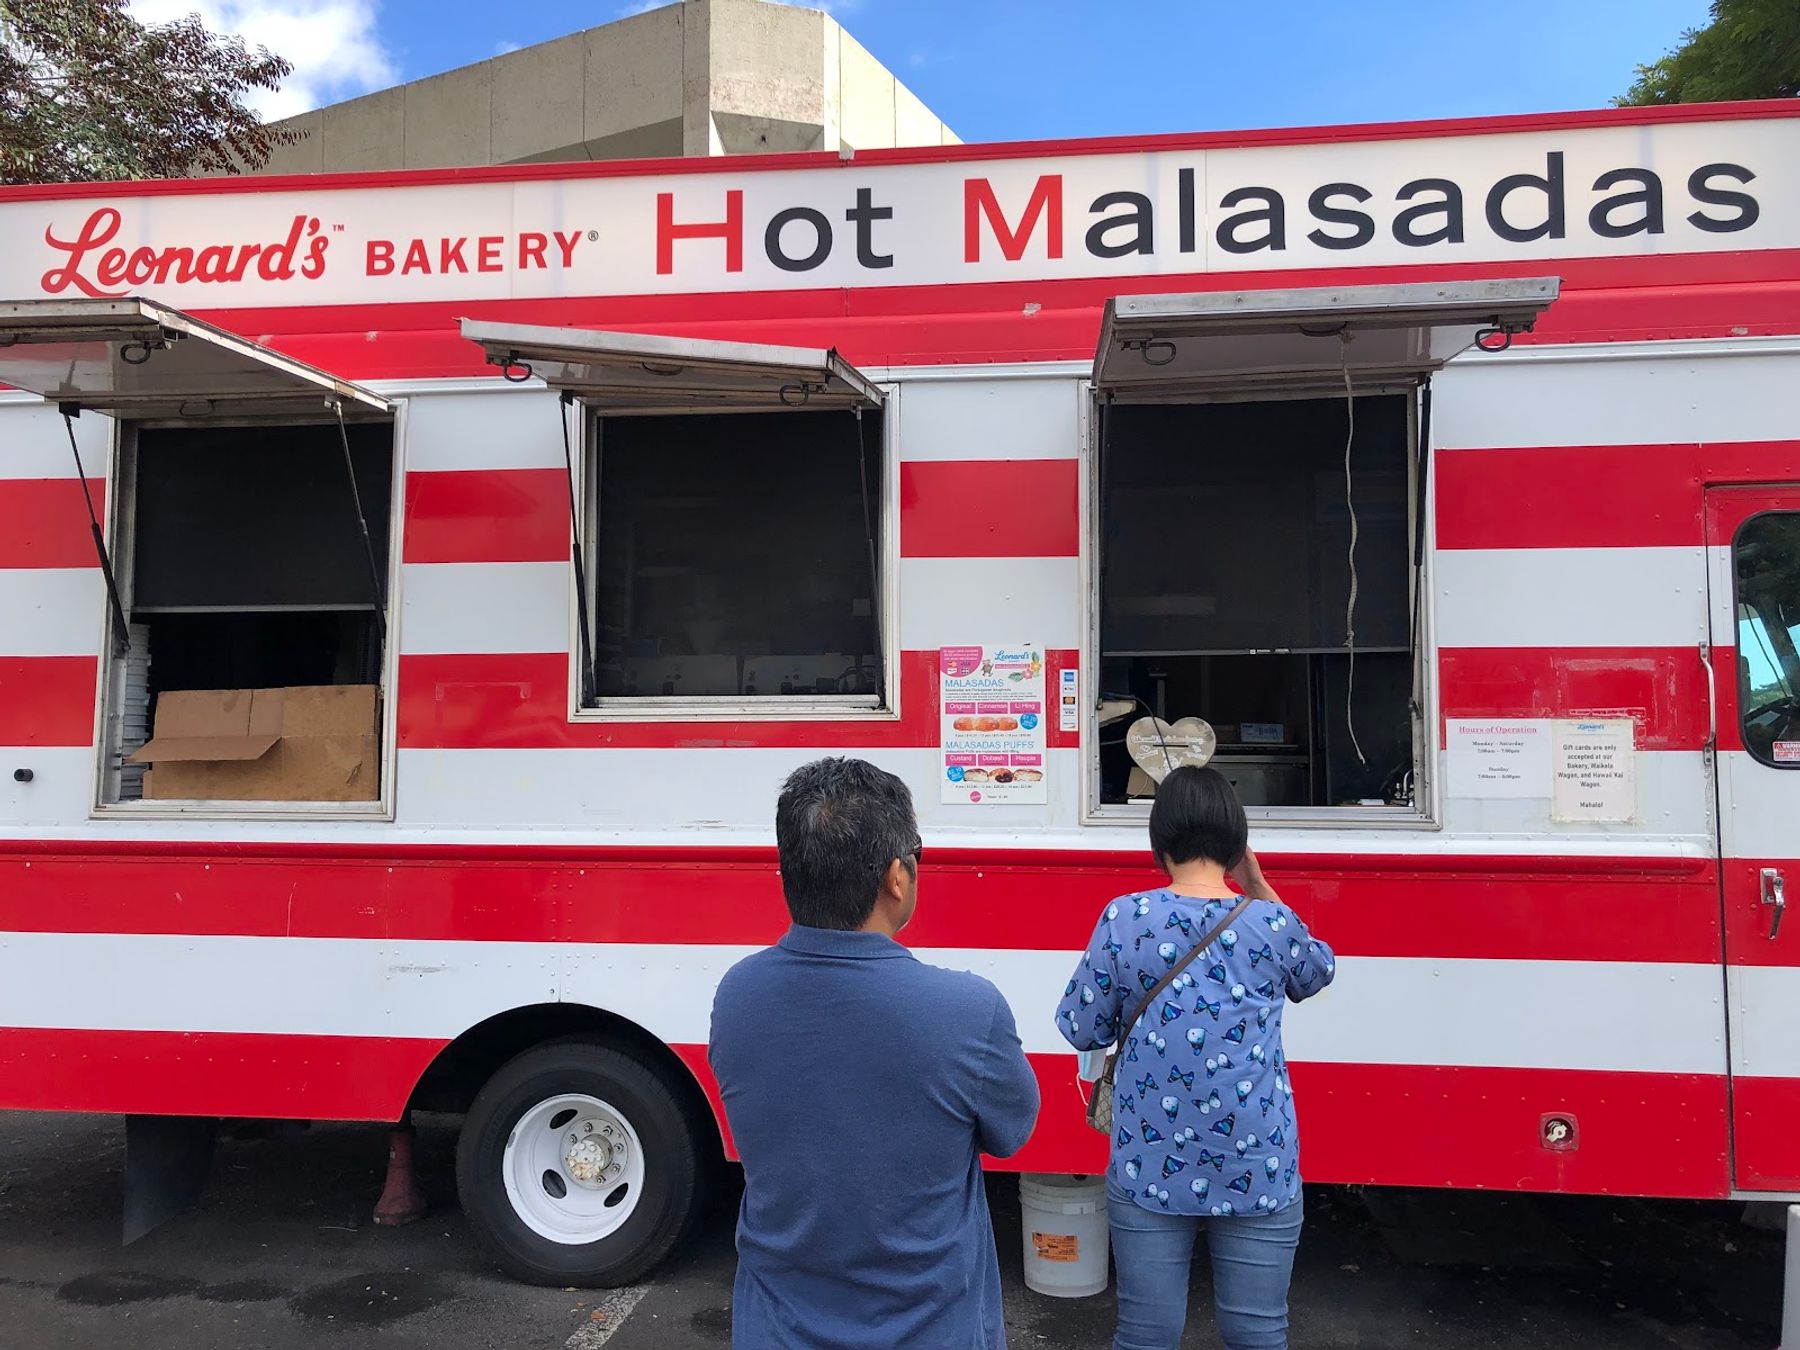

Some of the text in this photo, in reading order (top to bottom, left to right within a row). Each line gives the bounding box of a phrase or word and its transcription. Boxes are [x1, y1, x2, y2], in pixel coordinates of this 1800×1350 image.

[656, 150, 1760, 275] Hot Malasadas
[41, 207, 330, 298] Leonard's
[365, 231, 582, 277] BAKERY
[994, 650, 1030, 661] Leonard's
[945, 679, 1005, 688] MALASADAS
[1459, 726, 1537, 735] Hours of Operation
[945, 741, 1034, 749] MALASADAS PUFFS
[1604, 744, 1616, 752] only
